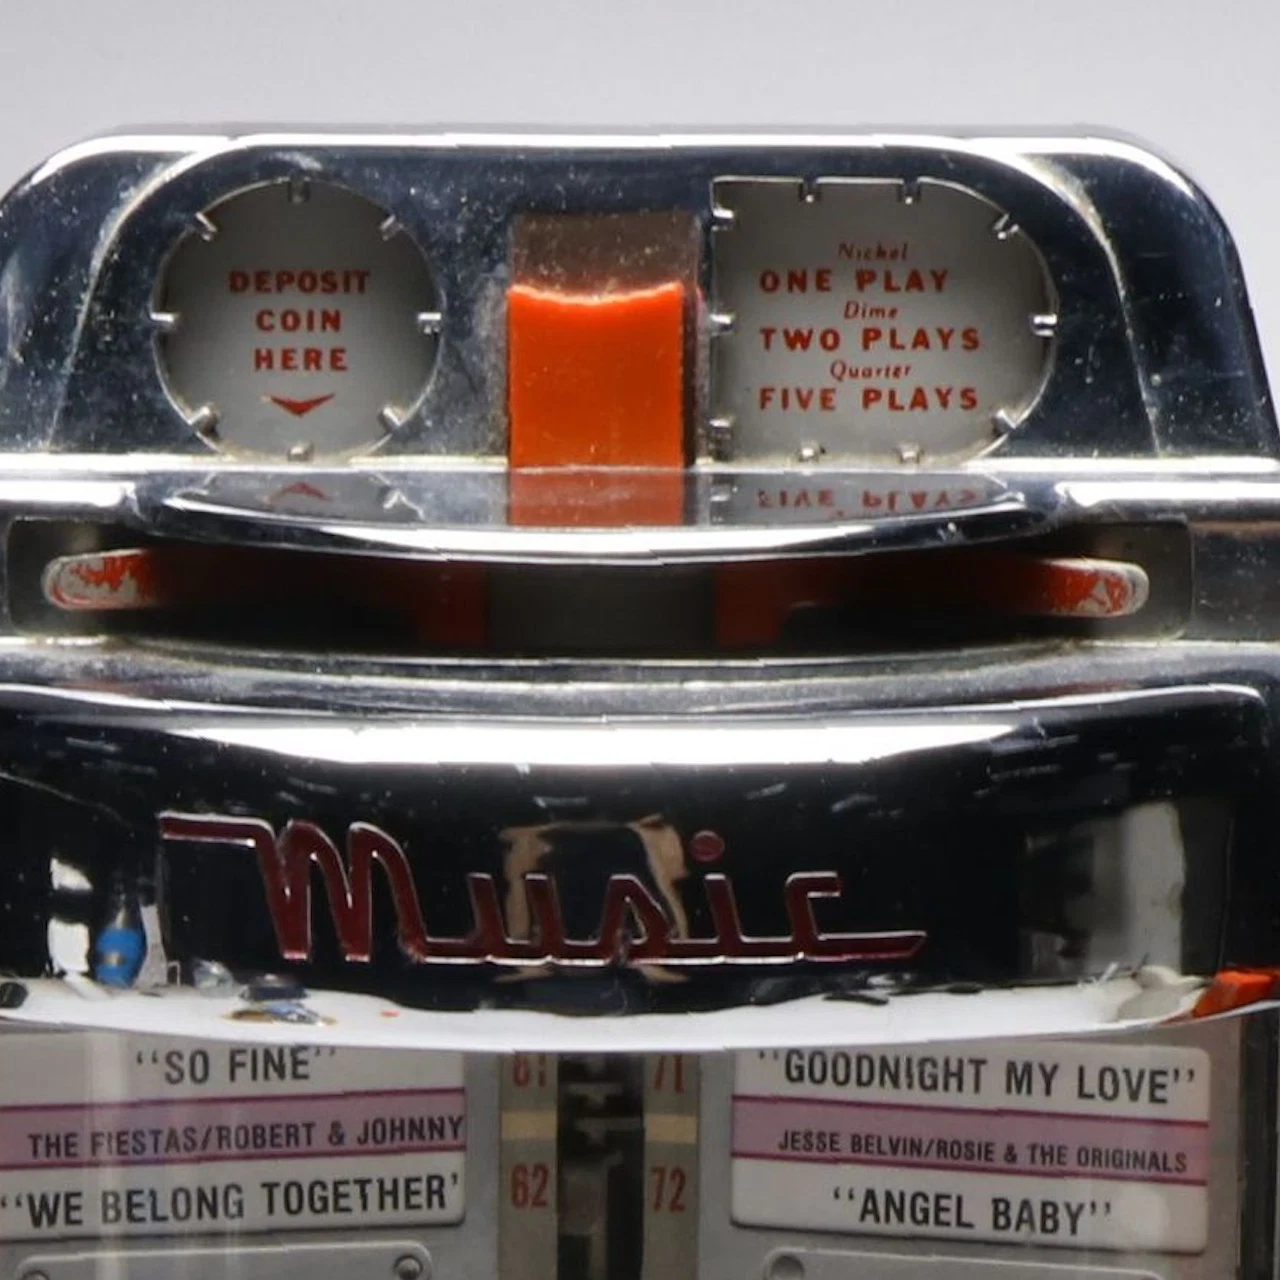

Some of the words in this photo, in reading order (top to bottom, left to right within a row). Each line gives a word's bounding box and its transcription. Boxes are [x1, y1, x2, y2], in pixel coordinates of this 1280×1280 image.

[838, 242, 908, 261] Nickel
[229, 269, 370, 294] DEPOSIT
[760, 268, 832, 293] ONE
[855, 269, 948, 293] PLAY
[256, 308, 341, 333] COIN
[844, 300, 898, 320] Dime
[760, 327, 841, 351] TWO
[862, 327, 980, 351] PLAYS
[254, 347, 348, 371] HERE
[829, 359, 912, 381] Quarter
[759, 388, 837, 411] FIVE
[862, 387, 978, 411] PLAYS
[158, 811, 926, 966] Music
[1006, 1062, 1060, 1096] MY
[29, 1133, 78, 1159] THE
[91, 1121, 314, 1157] FIESTAS/ROBERT
[329, 1121, 345, 1146] &
[356, 1115, 464, 1145] JOHNNY
[778, 1130, 840, 1153] JESSE
[850, 1134, 995, 1163] BELVIN/ROSIE
[1004, 1144, 1018, 1163] &
[1028, 1144, 1067, 1166] THE
[1077, 1147, 1187, 1173] ORIGINALS
[511, 1164, 548, 1208] 62
[651, 1167, 686, 1213] 72
[101, 1184, 244, 1225] BELONG
